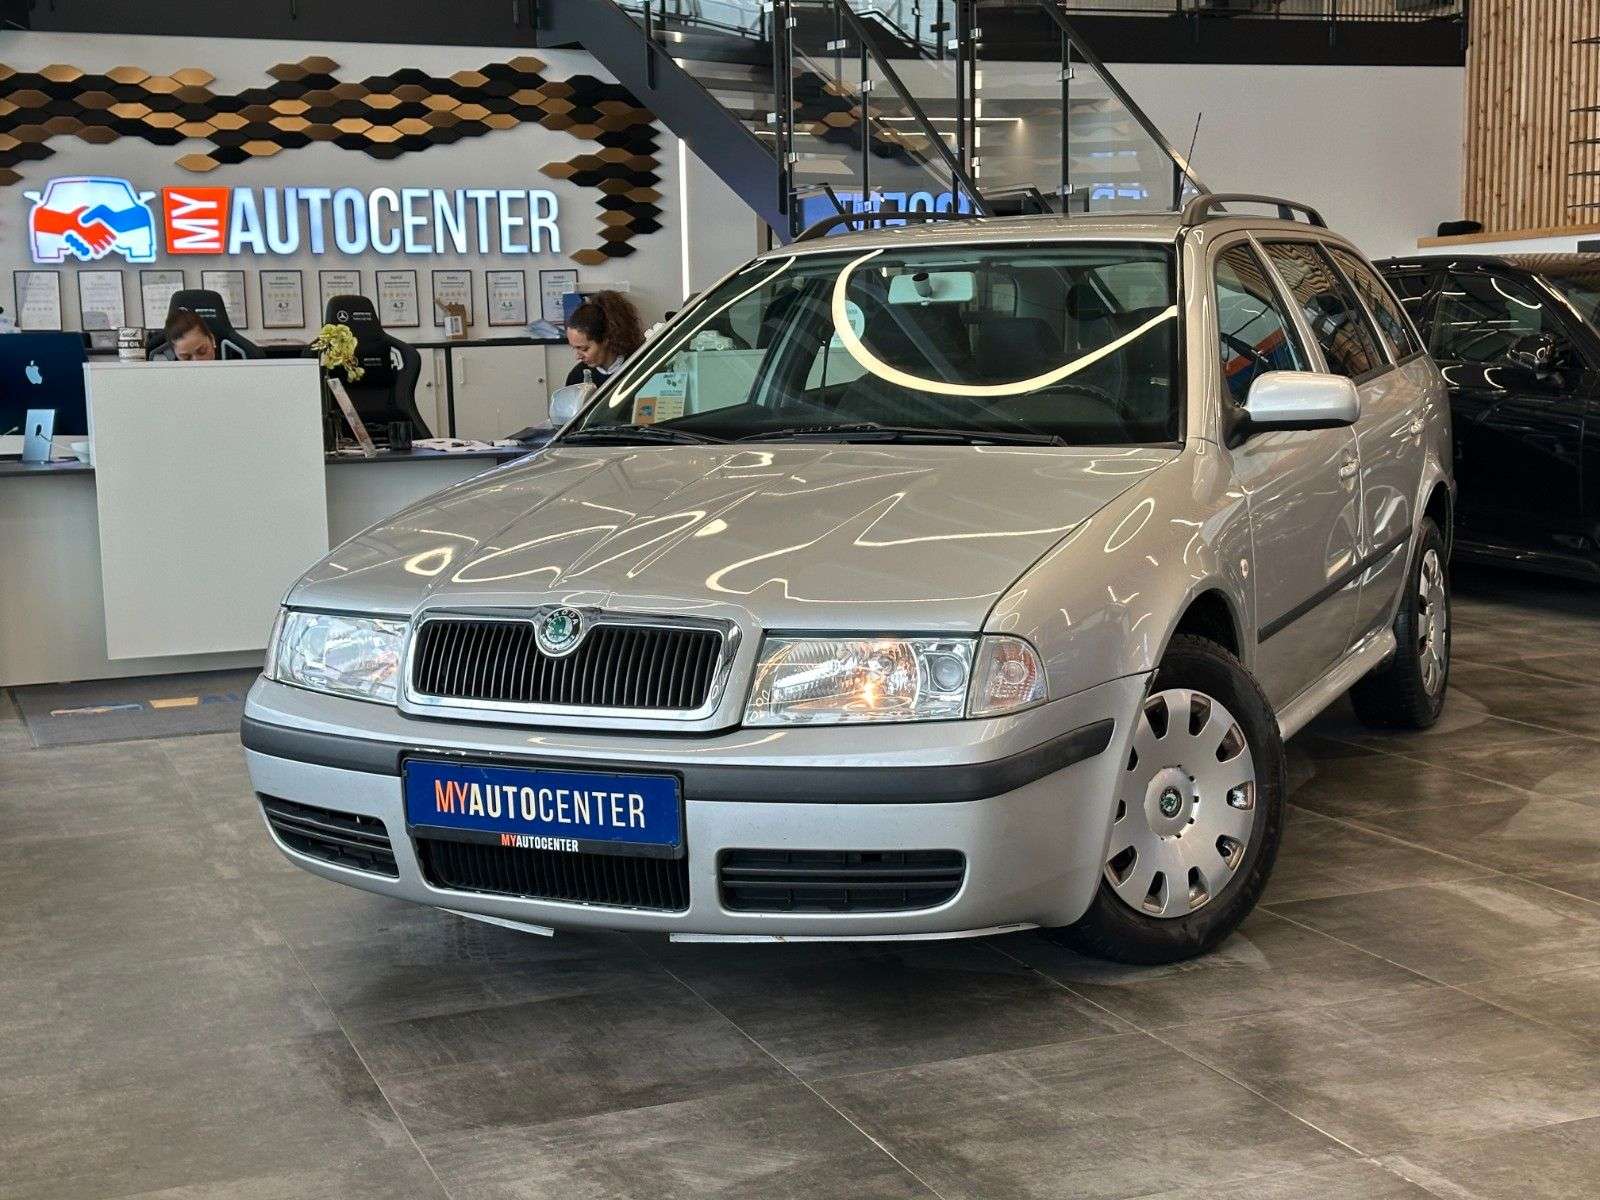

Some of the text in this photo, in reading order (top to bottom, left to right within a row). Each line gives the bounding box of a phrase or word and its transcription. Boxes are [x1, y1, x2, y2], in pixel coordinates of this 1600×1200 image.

[169, 192, 222, 250] MY
[228, 186, 562, 256] AUTOCENTER
[434, 779, 646, 828] MYAUTOCENTER
[501, 833, 578, 853] MYAUTOCENTER
